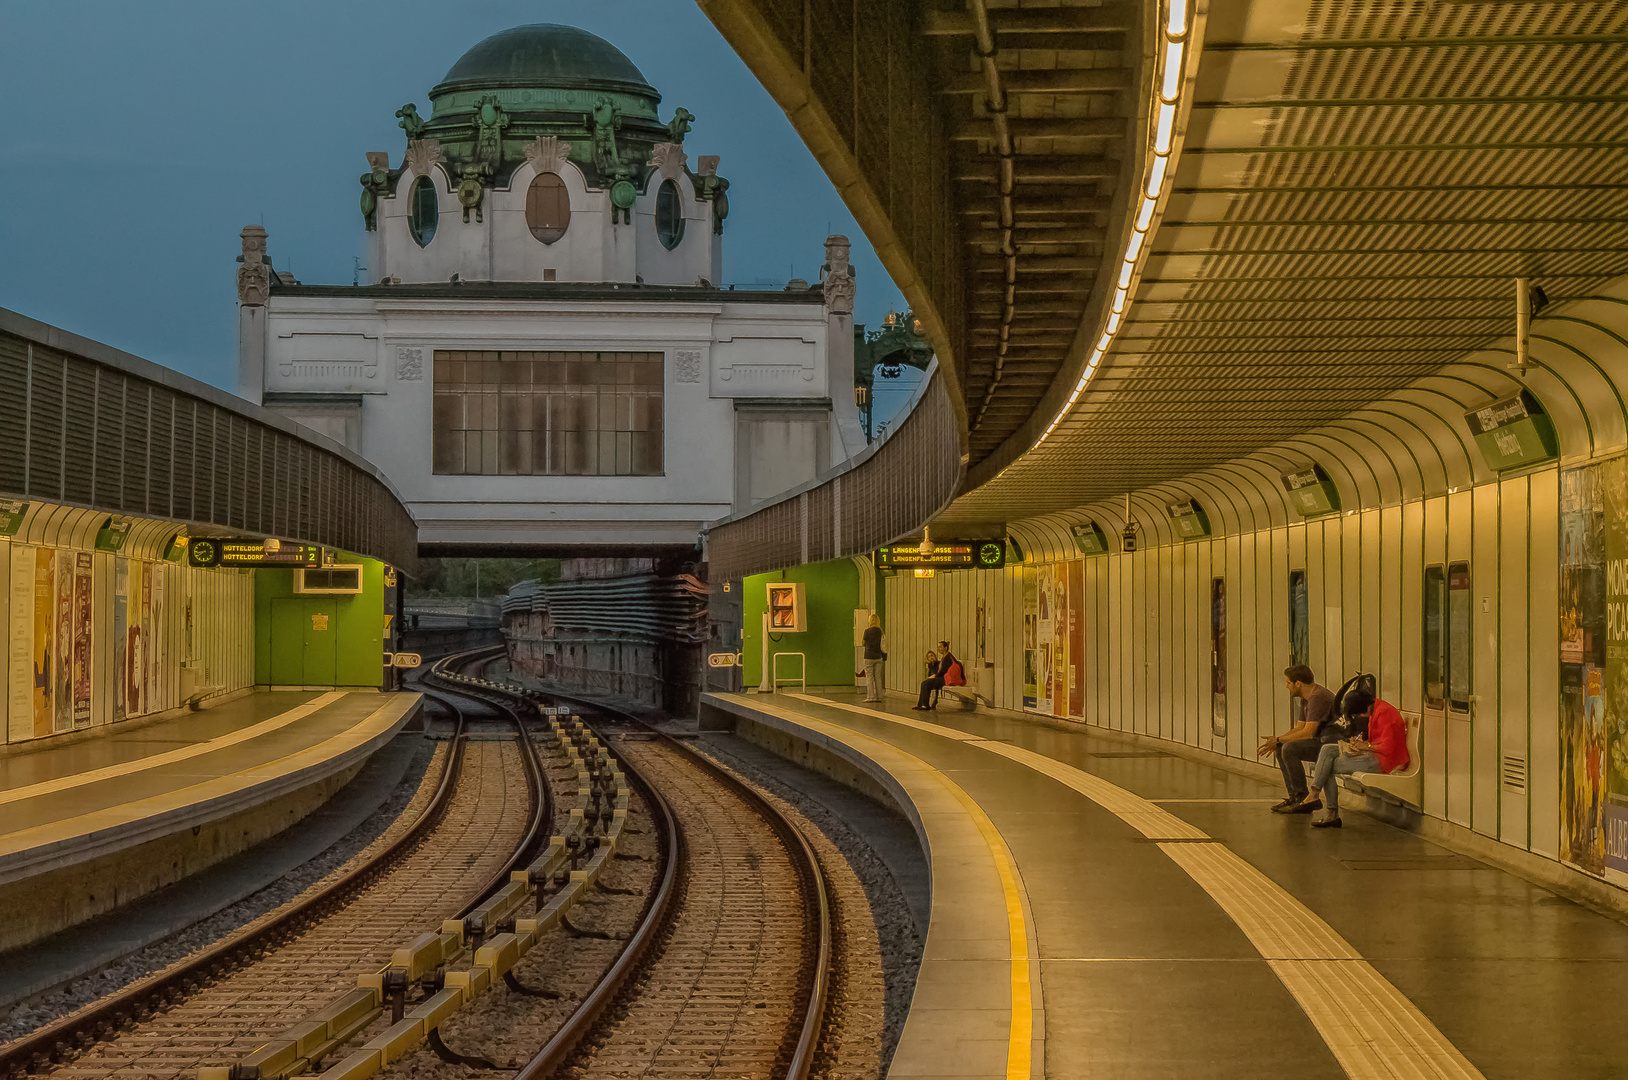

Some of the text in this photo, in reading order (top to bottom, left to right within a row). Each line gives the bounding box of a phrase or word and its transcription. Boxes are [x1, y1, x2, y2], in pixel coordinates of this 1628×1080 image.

[309, 553, 315, 561] 2
[882, 554, 887, 562] 1
[1607, 559, 1628, 596] MONE
